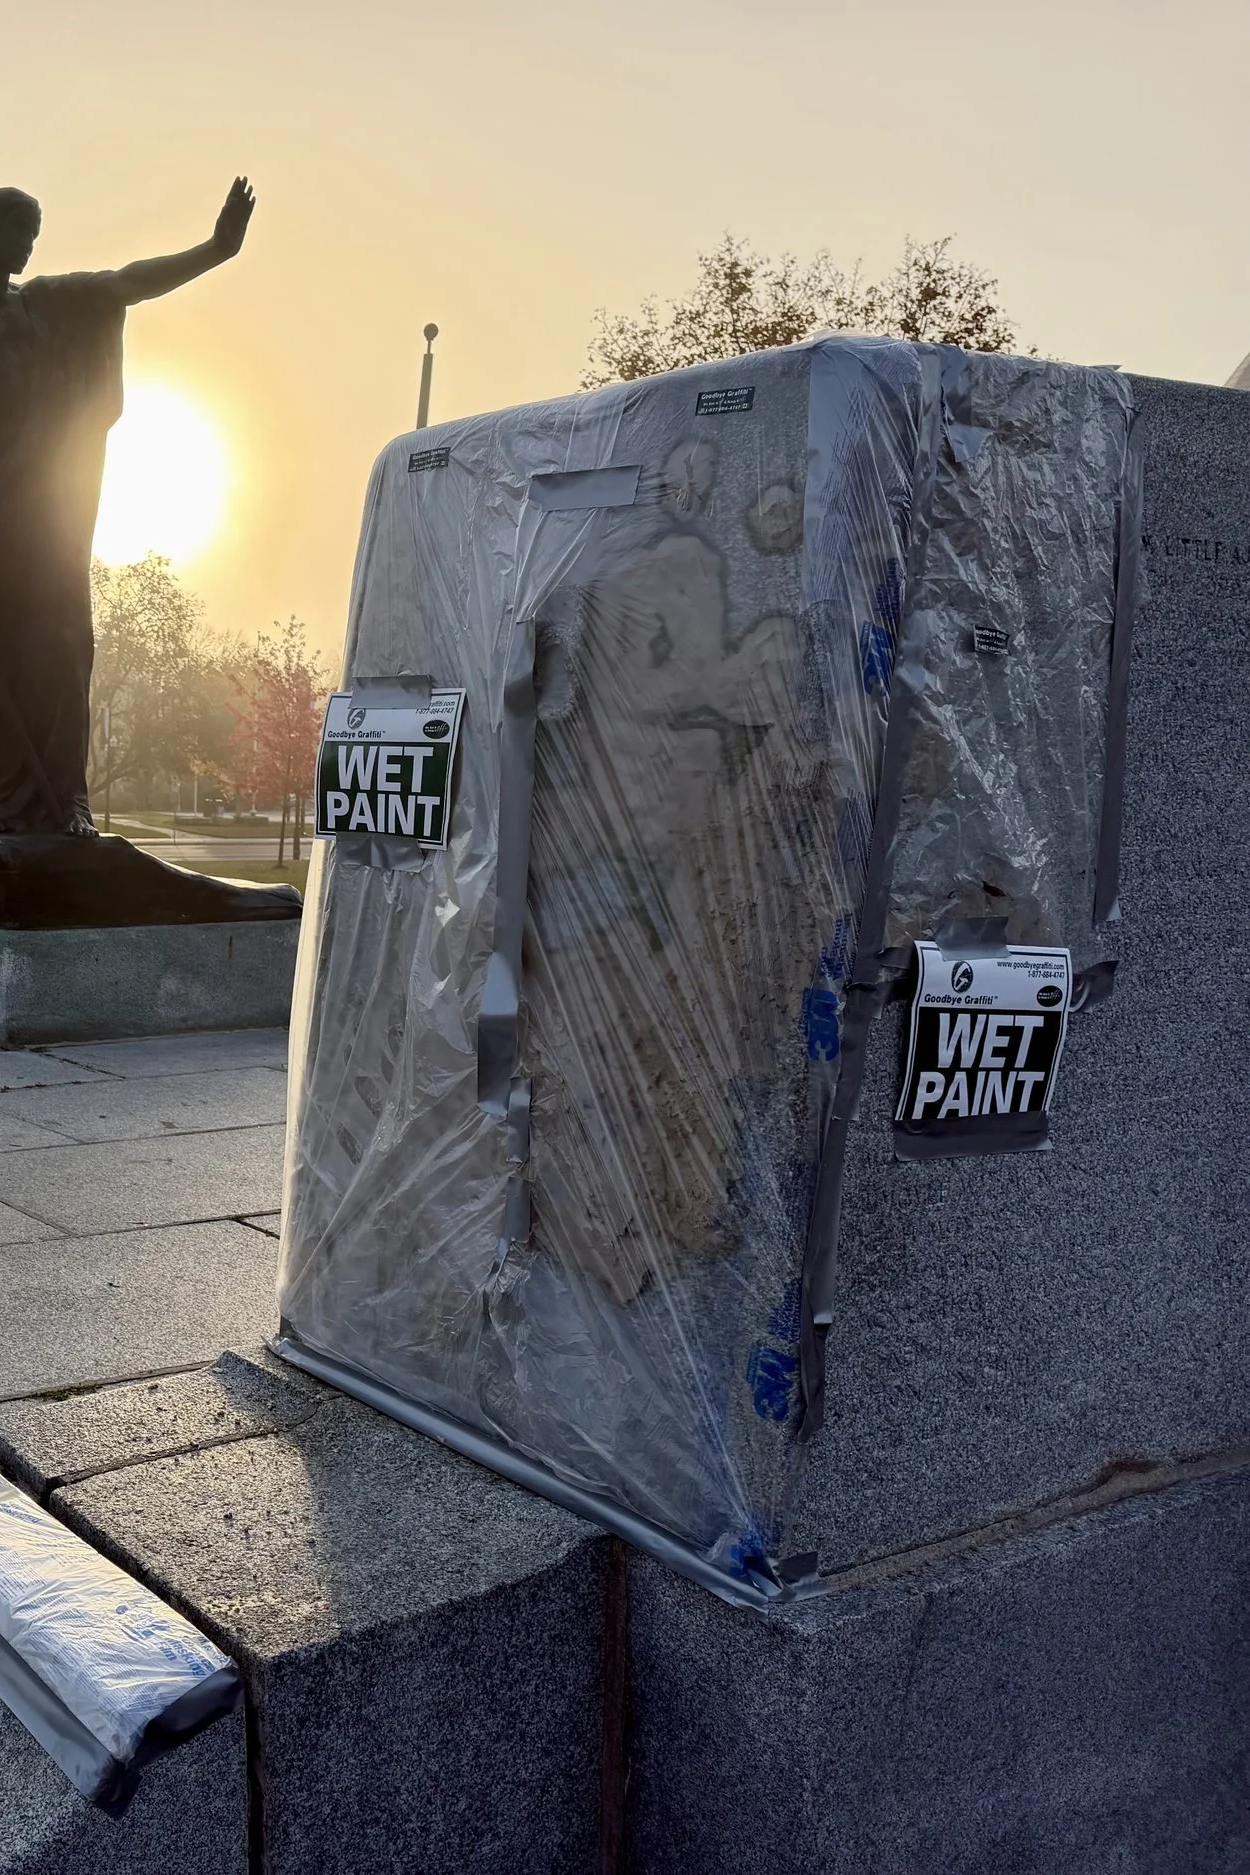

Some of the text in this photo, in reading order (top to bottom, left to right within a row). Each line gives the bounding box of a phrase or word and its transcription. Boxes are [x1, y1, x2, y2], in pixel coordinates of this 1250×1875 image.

[327, 730, 356, 740] Goodbye
[338, 745, 434, 793] WET
[327, 791, 441, 837] PAINT
[996, 961, 1065, 971] www.goodbyegraffiti.com
[924, 993, 962, 1006] Goodbye
[937, 1012, 1045, 1068] WET
[911, 1071, 1046, 1120] PAINT
